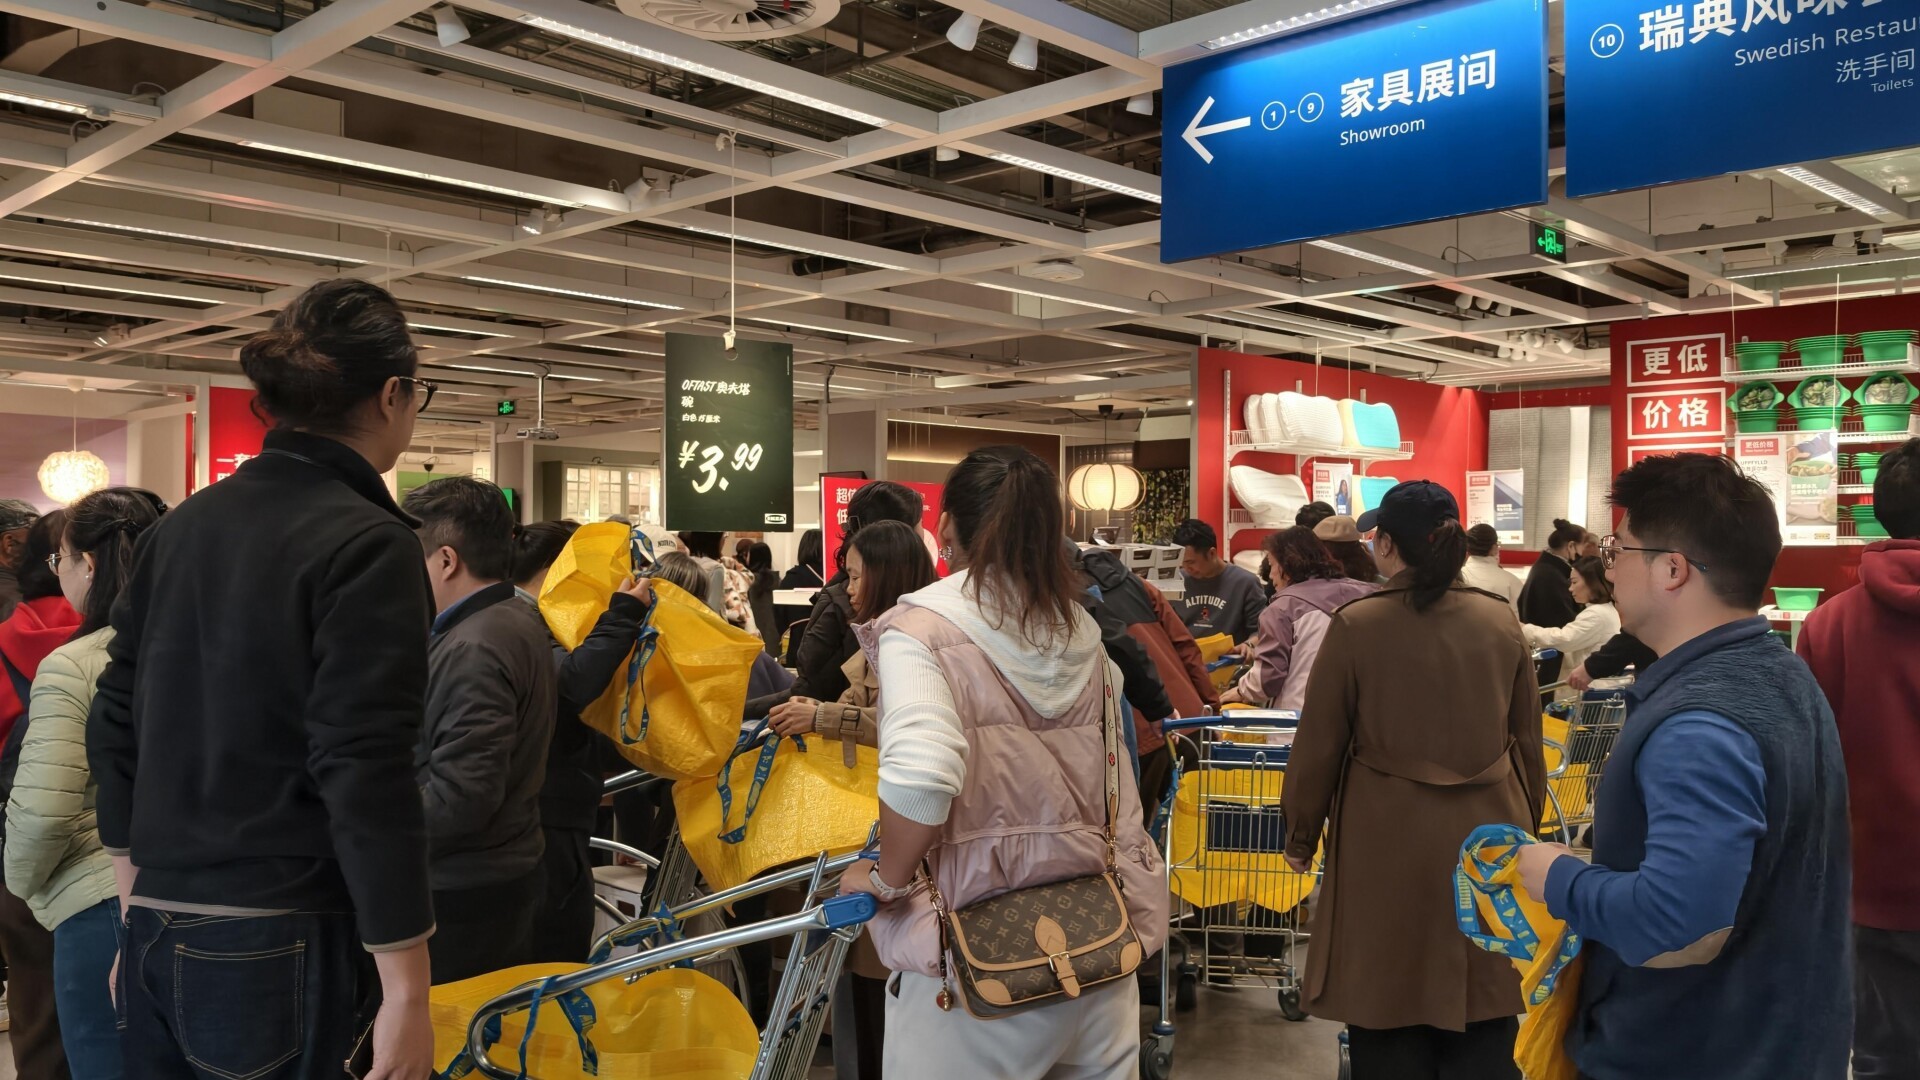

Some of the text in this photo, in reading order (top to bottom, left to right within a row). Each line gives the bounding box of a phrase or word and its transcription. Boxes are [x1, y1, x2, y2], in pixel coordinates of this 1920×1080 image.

[1639, 0, 1882, 52] 瑞典风
[1734, 34, 1824, 66] Swedish
[1836, 48, 1915, 83] 洗手间
[1340, 49, 1496, 119] 家具展间
[1872, 78, 1914, 93] Toilets
[1340, 118, 1425, 146] Showroom
[1642, 343, 1708, 377] 更低
[681, 379, 717, 393] OFTAST
[1642, 397, 1710, 430] 价格
[1186, 595, 1227, 609] ALTITUDE
